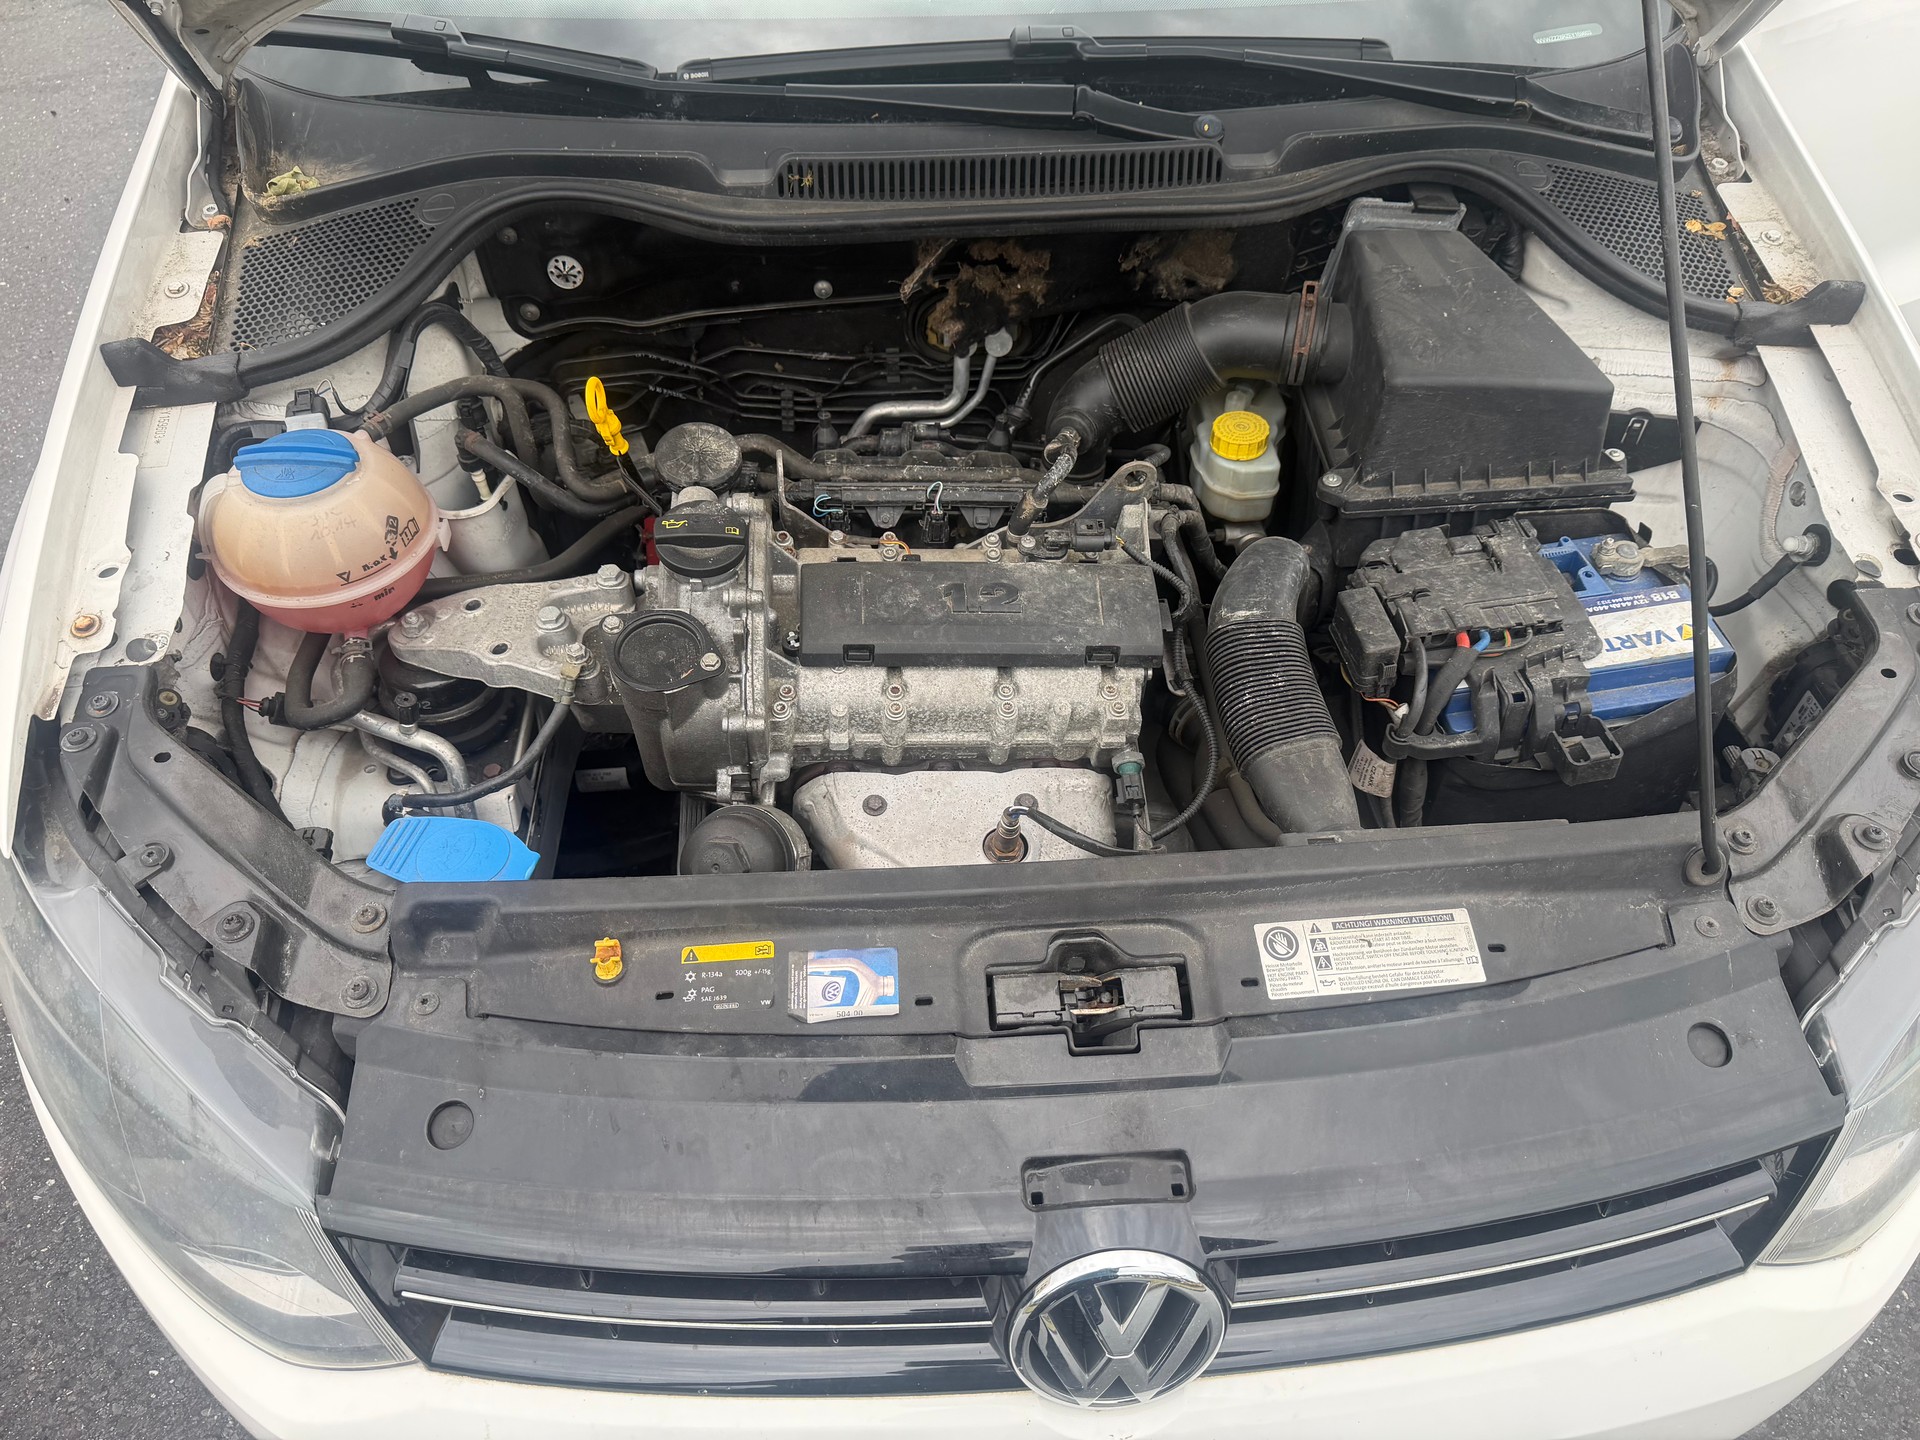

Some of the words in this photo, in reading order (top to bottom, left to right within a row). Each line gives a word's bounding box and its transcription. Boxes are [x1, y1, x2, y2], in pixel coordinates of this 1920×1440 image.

[1649, 590, 1681, 602] B18
[1610, 600, 1632, 609] 44Ah
[1634, 598, 1649, 606] 12V
[1585, 603, 1609, 613] 440A
[1604, 630, 1676, 652] VART
[1336, 920, 1372, 929] ACHTUNG!
[1374, 916, 1410, 926] WARNING!
[1412, 914, 1451, 923] ATTENTION!
